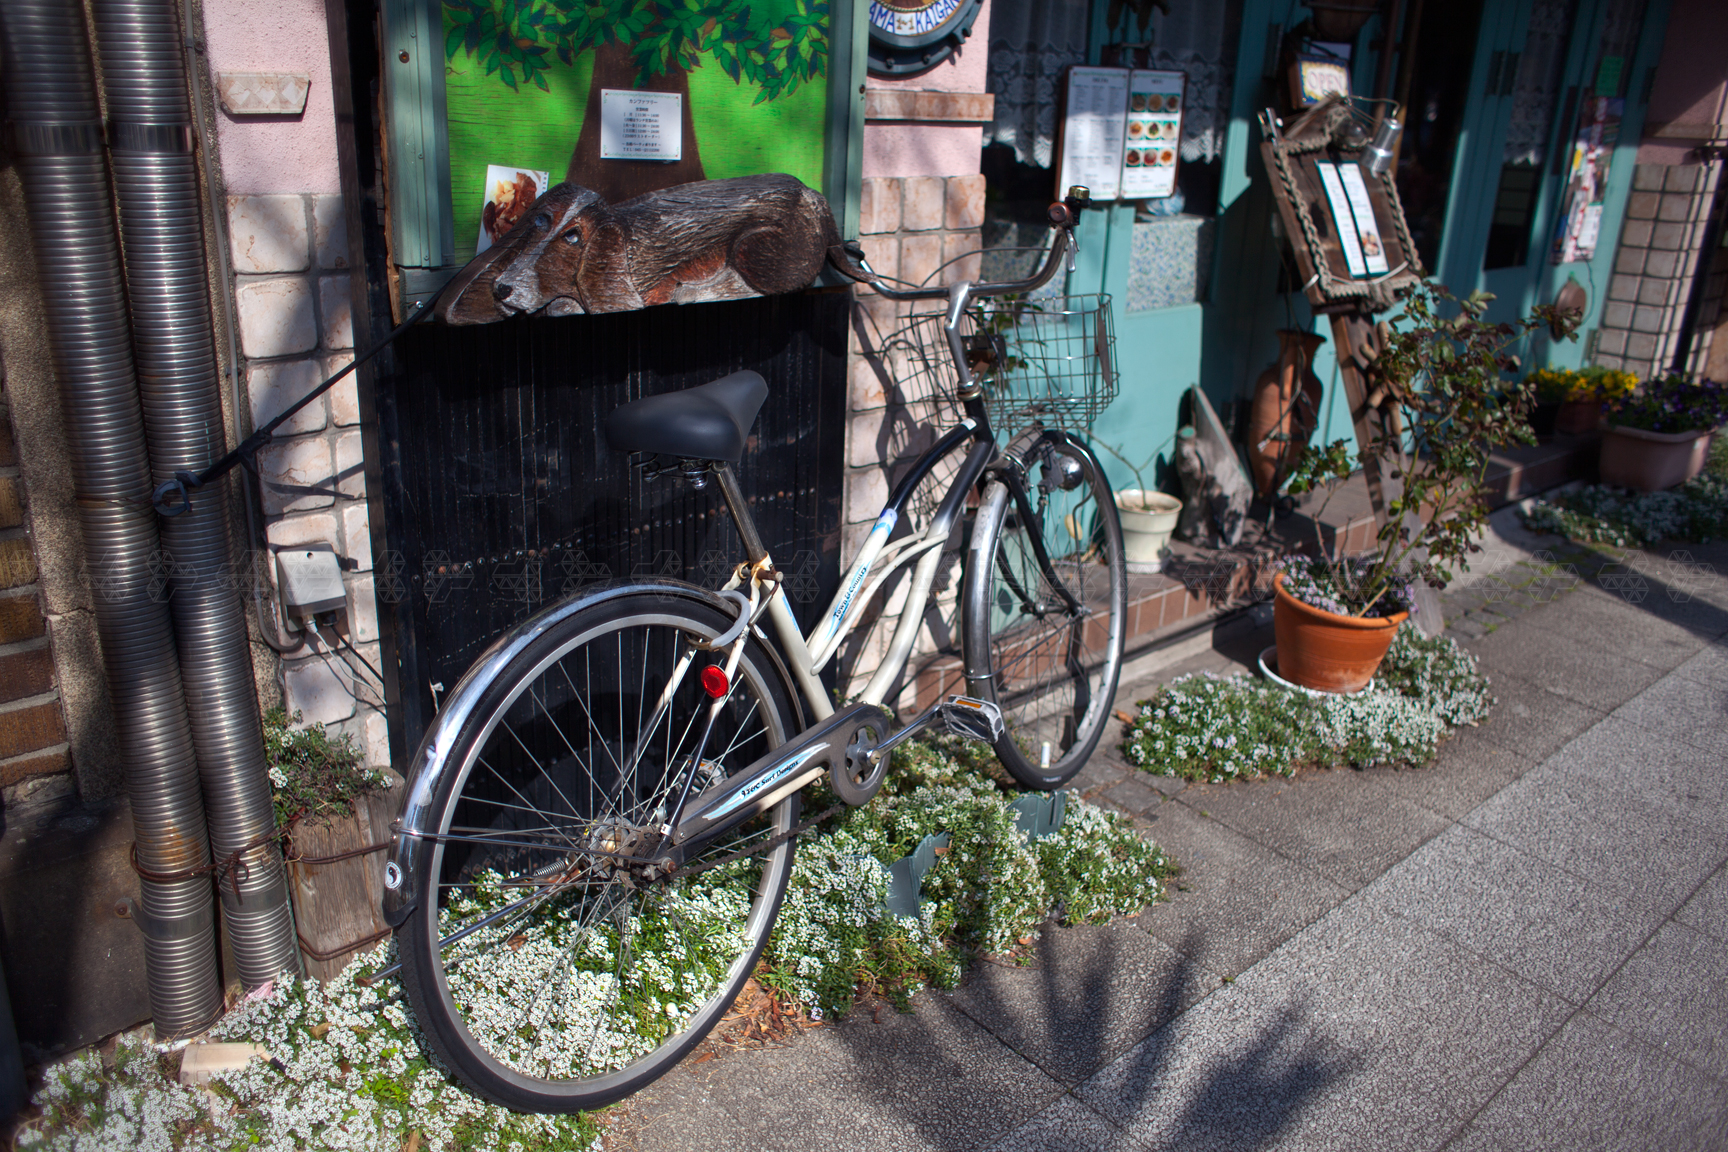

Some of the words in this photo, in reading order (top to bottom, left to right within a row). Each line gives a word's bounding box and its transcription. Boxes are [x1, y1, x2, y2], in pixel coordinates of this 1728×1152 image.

[1307, 71, 1345, 92] OPEN
[833, 599, 847, 618] Town
[848, 566, 867, 593] Country
[761, 774, 775, 785] Surf
[777, 760, 799, 777] Designs
